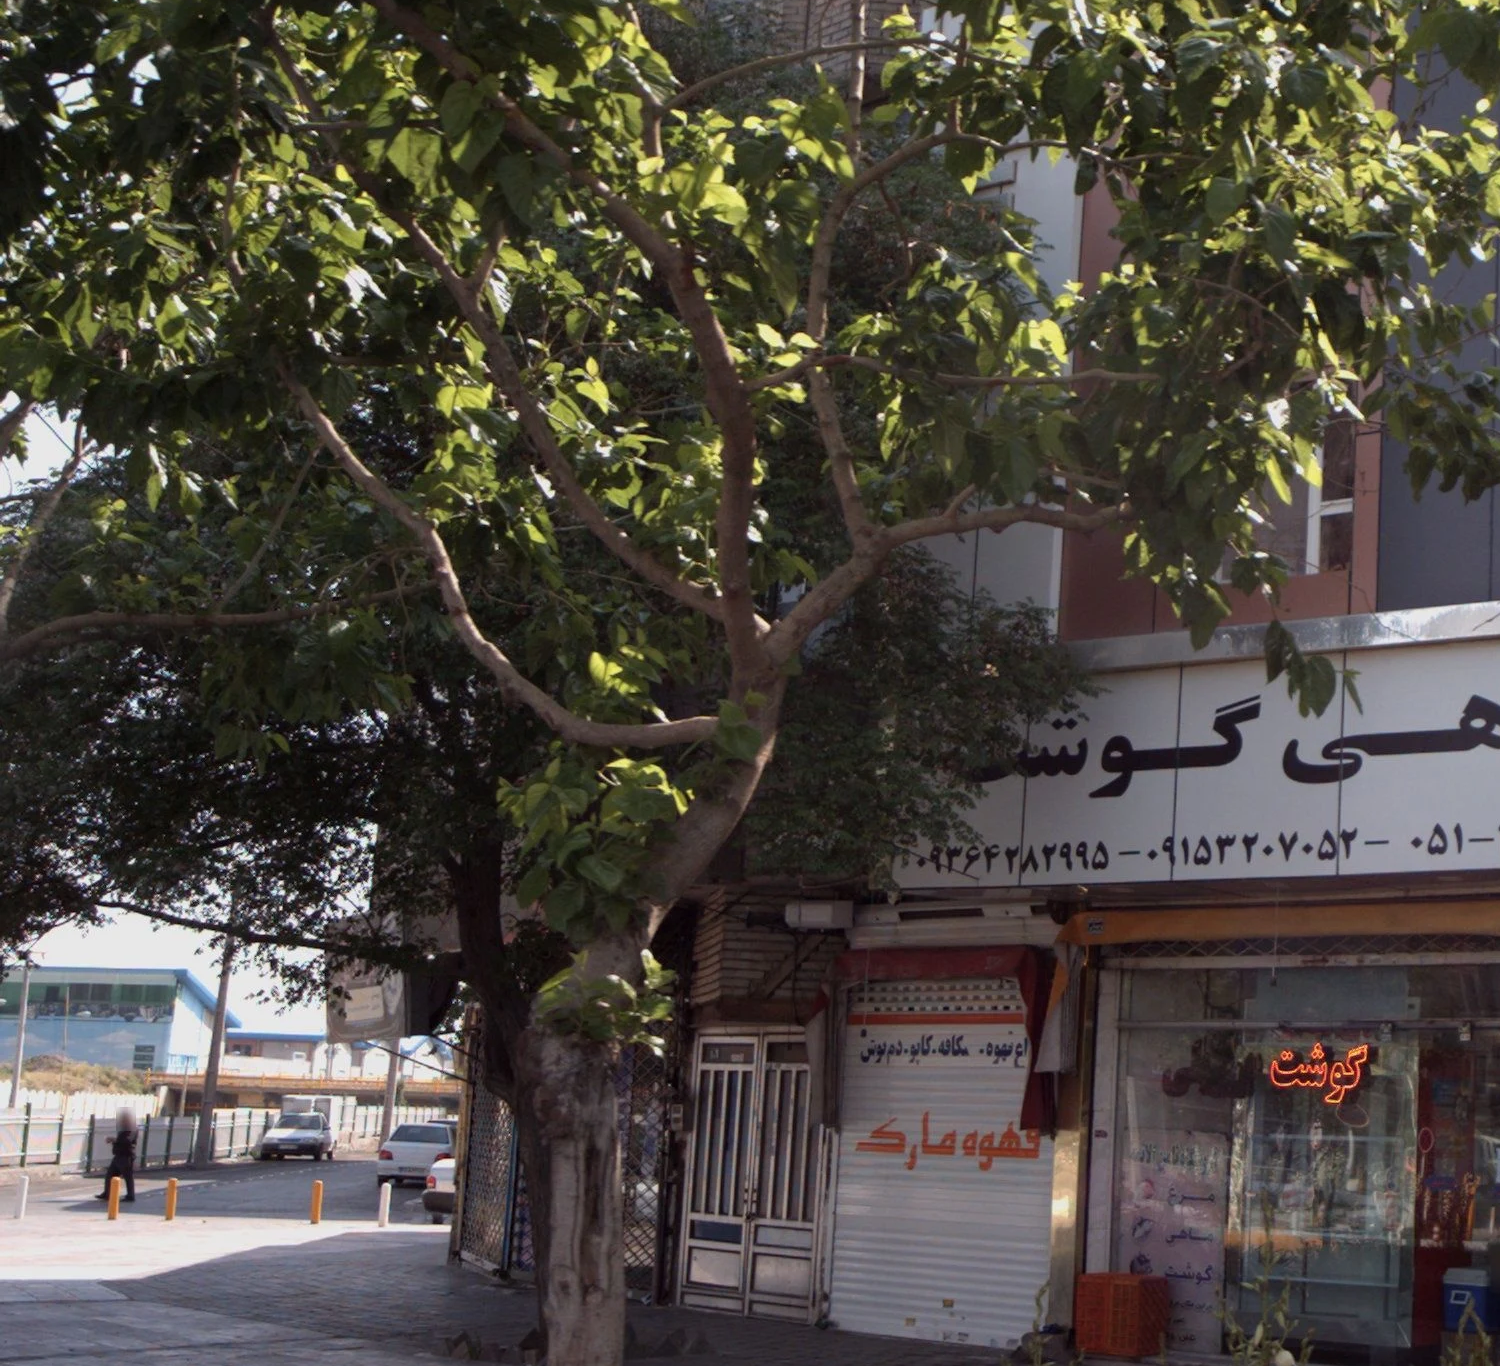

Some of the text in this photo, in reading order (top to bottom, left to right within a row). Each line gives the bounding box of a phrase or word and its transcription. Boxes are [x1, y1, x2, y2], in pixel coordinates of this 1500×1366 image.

[962, 693, 1261, 799] گوش
[1270, 1042, 1369, 1104] گوشت
[855, 1108, 957, 1170] مارک
[1165, 1262, 1213, 1285] گوشت
